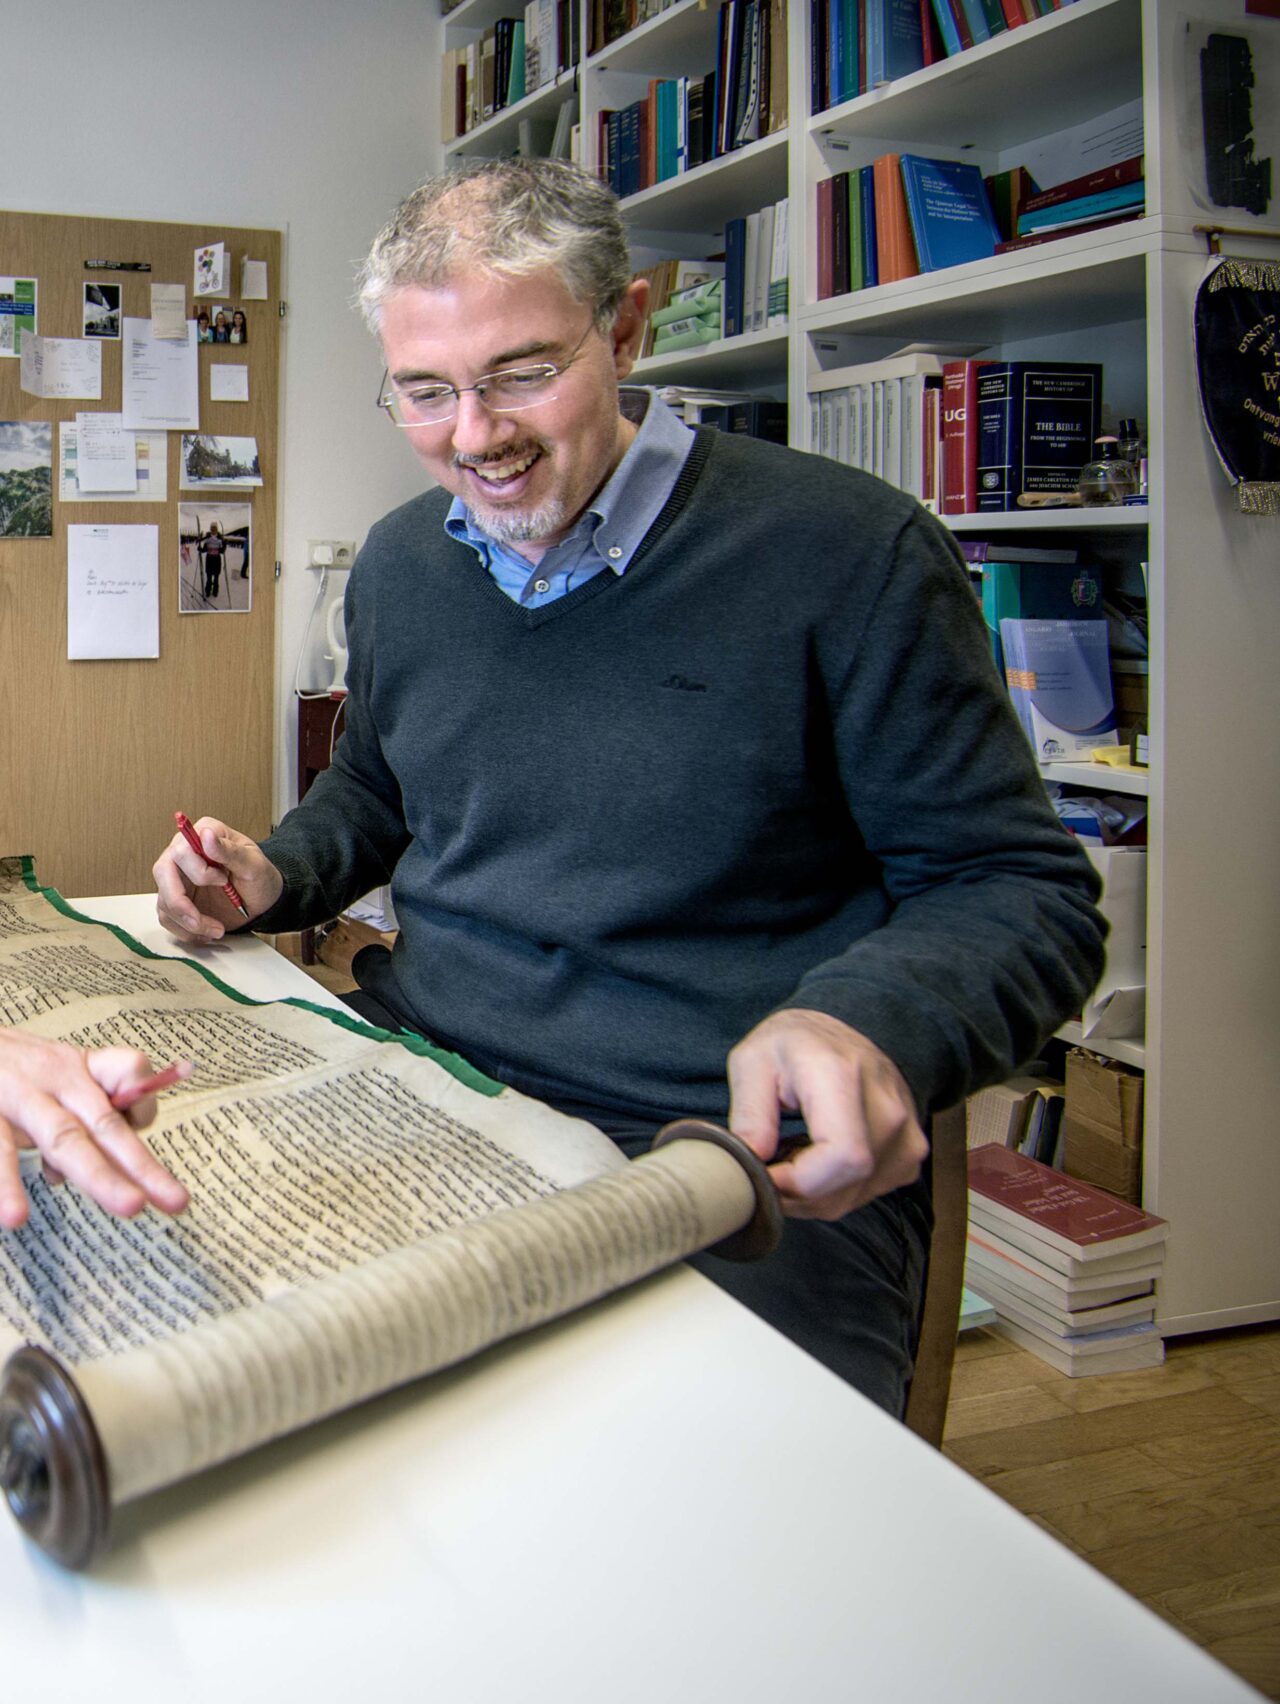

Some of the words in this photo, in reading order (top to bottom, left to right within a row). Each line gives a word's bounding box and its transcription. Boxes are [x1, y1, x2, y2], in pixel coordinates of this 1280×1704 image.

[944, 408, 967, 422] UG
[1035, 422, 1054, 431] THE
[1056, 423, 1081, 432] BIBLE
